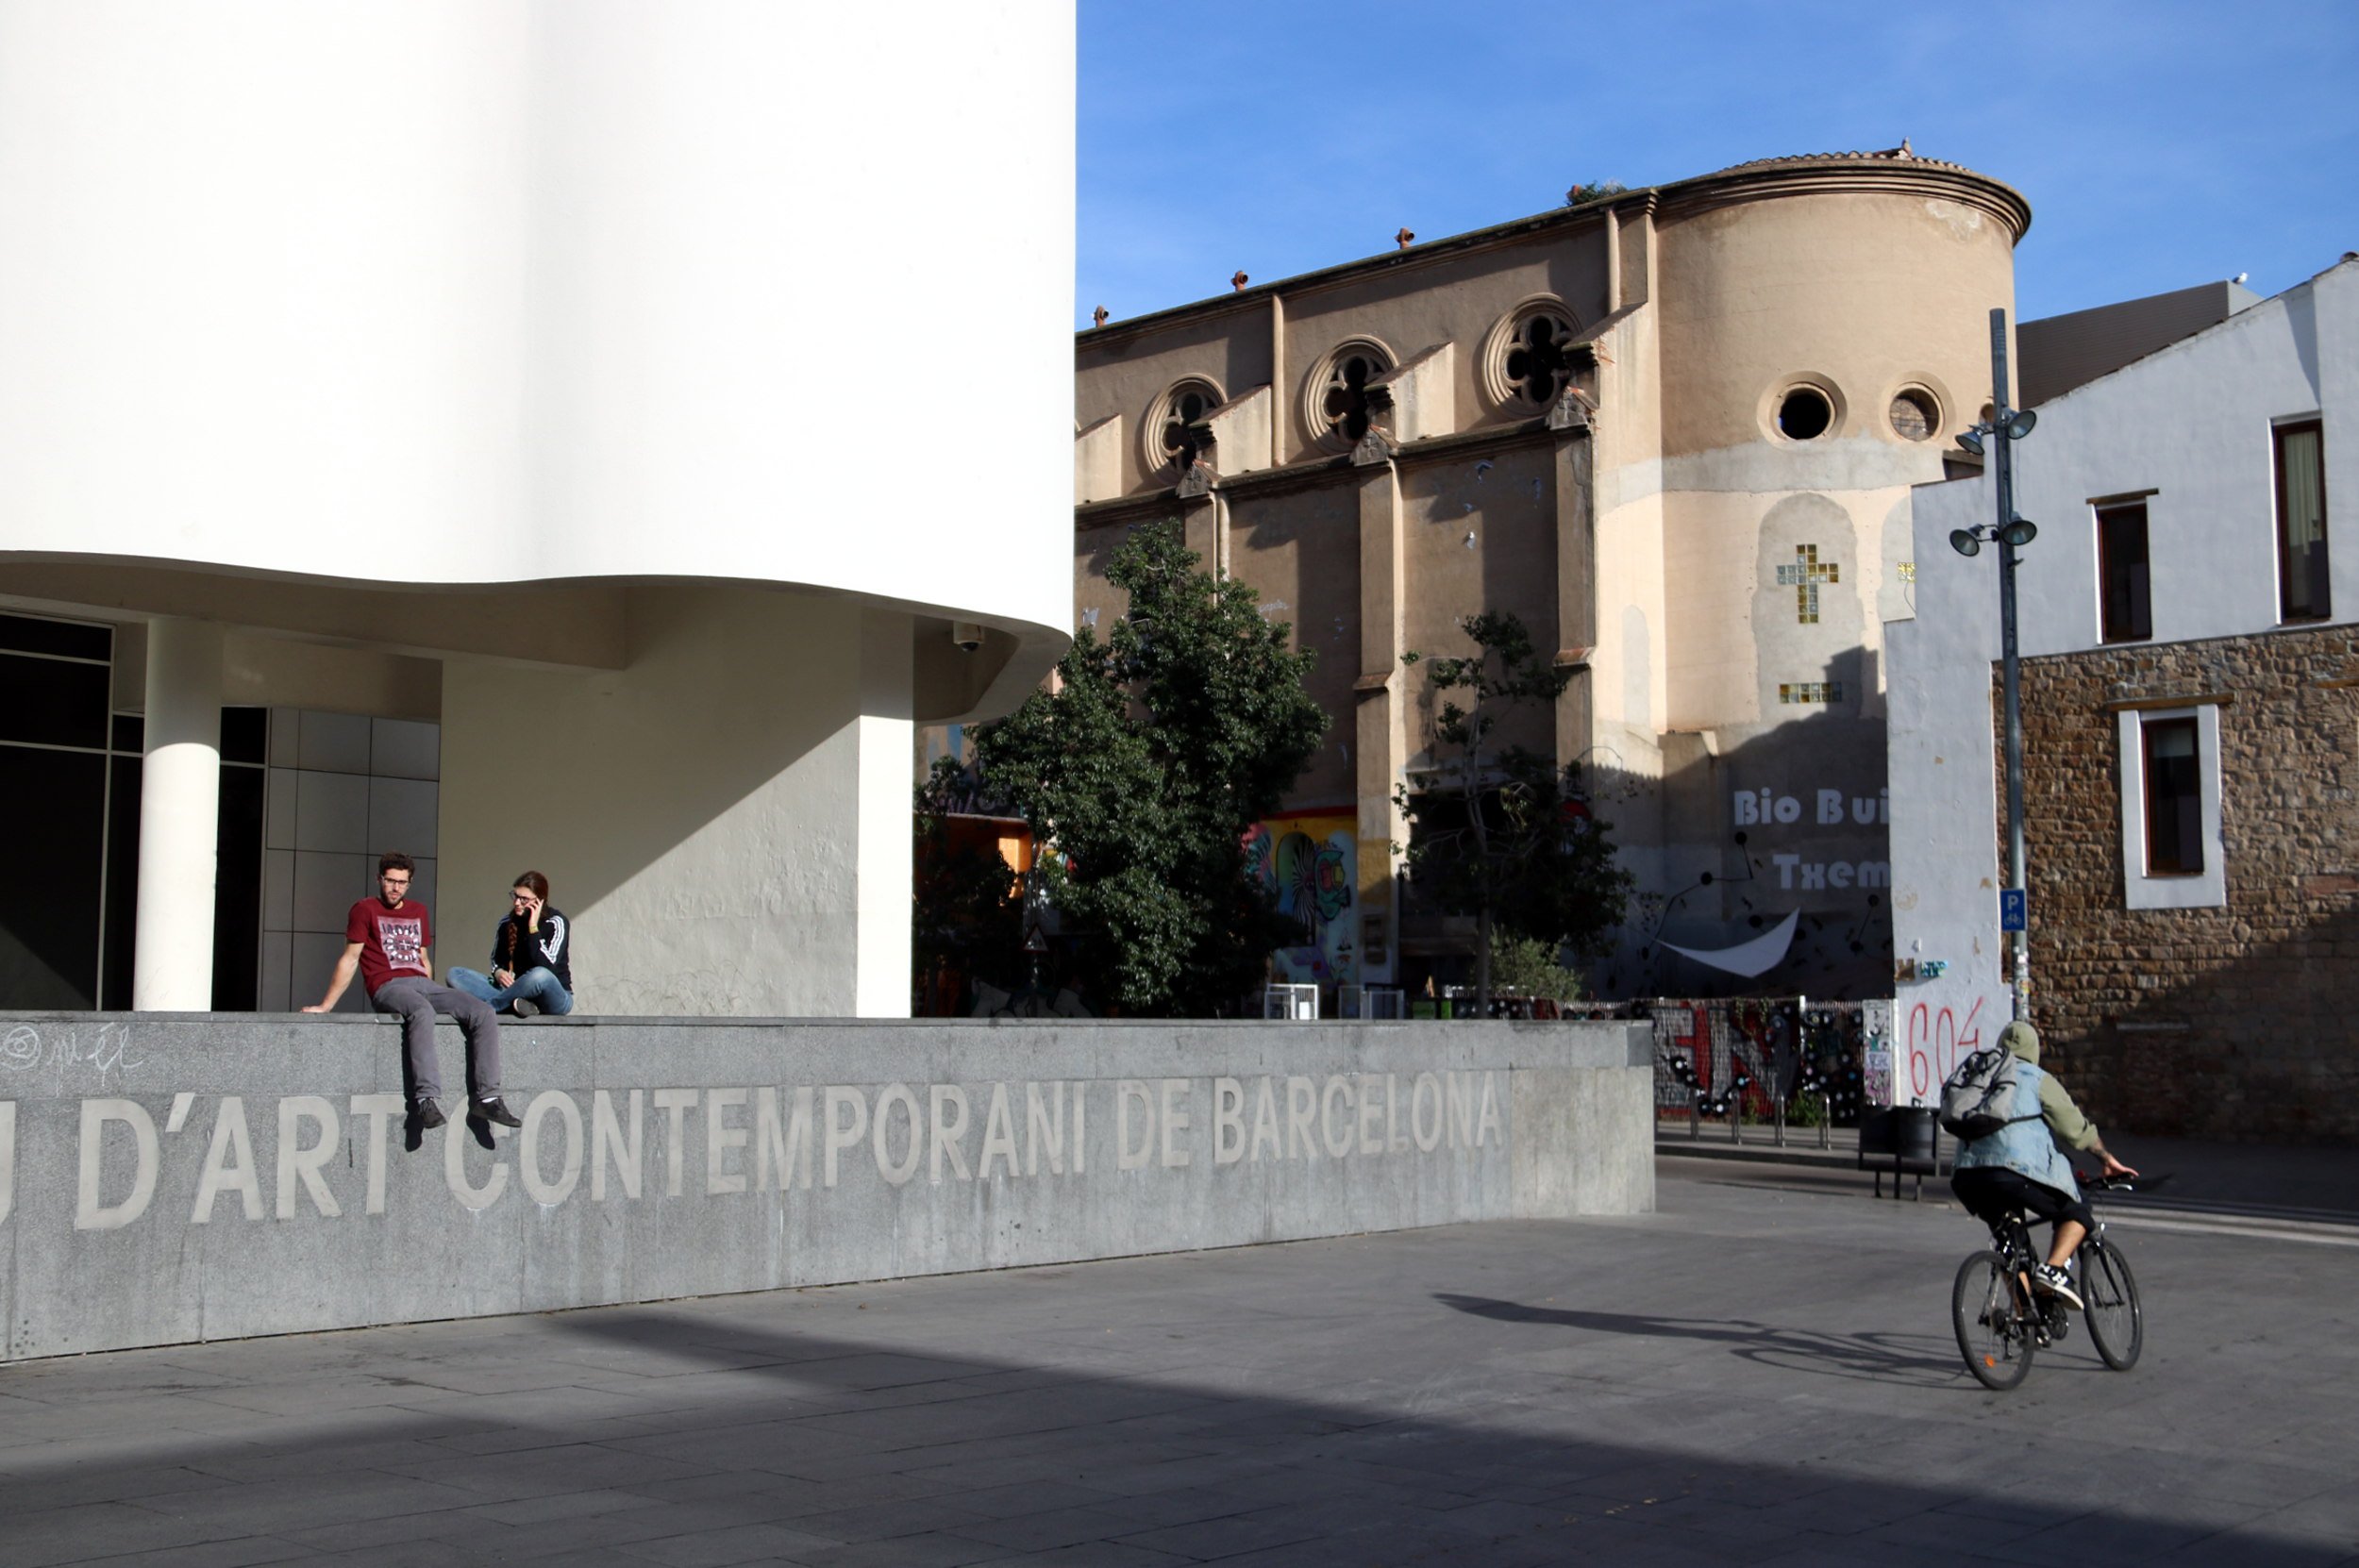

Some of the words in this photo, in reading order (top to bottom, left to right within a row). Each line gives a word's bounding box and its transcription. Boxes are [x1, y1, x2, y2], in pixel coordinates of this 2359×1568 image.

[1733, 787, 1801, 826] Bio
[2007, 894, 2019, 911] P
[75, 1092, 409, 1230] D'ART
[443, 1080, 1085, 1211] CONTEMPORANI
[1116, 1078, 1191, 1171] DE
[1213, 1070, 1503, 1165] BARCELONA
